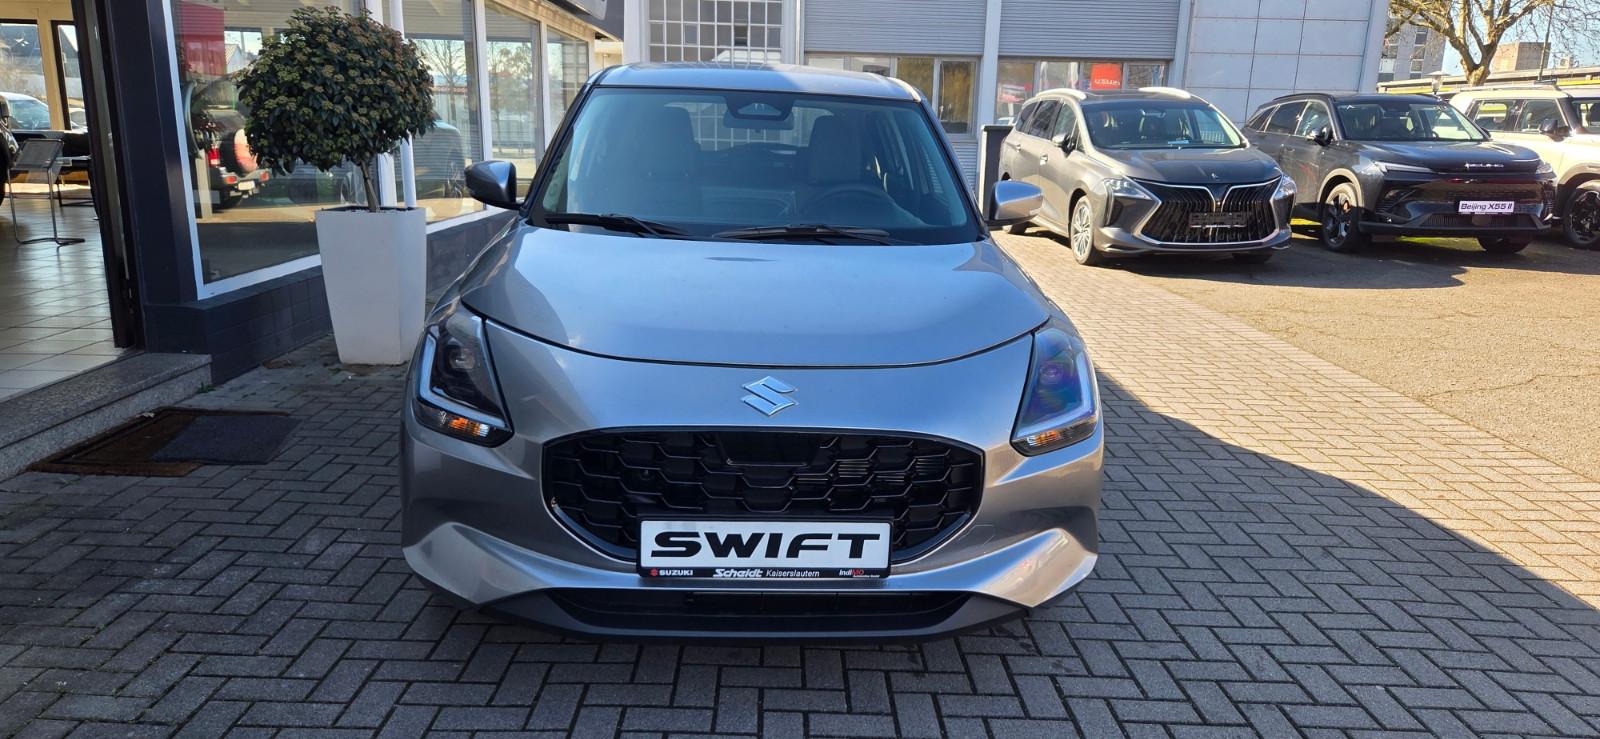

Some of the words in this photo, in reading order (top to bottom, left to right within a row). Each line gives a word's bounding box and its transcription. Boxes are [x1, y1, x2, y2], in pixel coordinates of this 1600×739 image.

[1461, 203, 1487, 211] Beijing
[650, 531, 881, 559] SWIFT
[766, 569, 820, 578] Kaiserslautern
